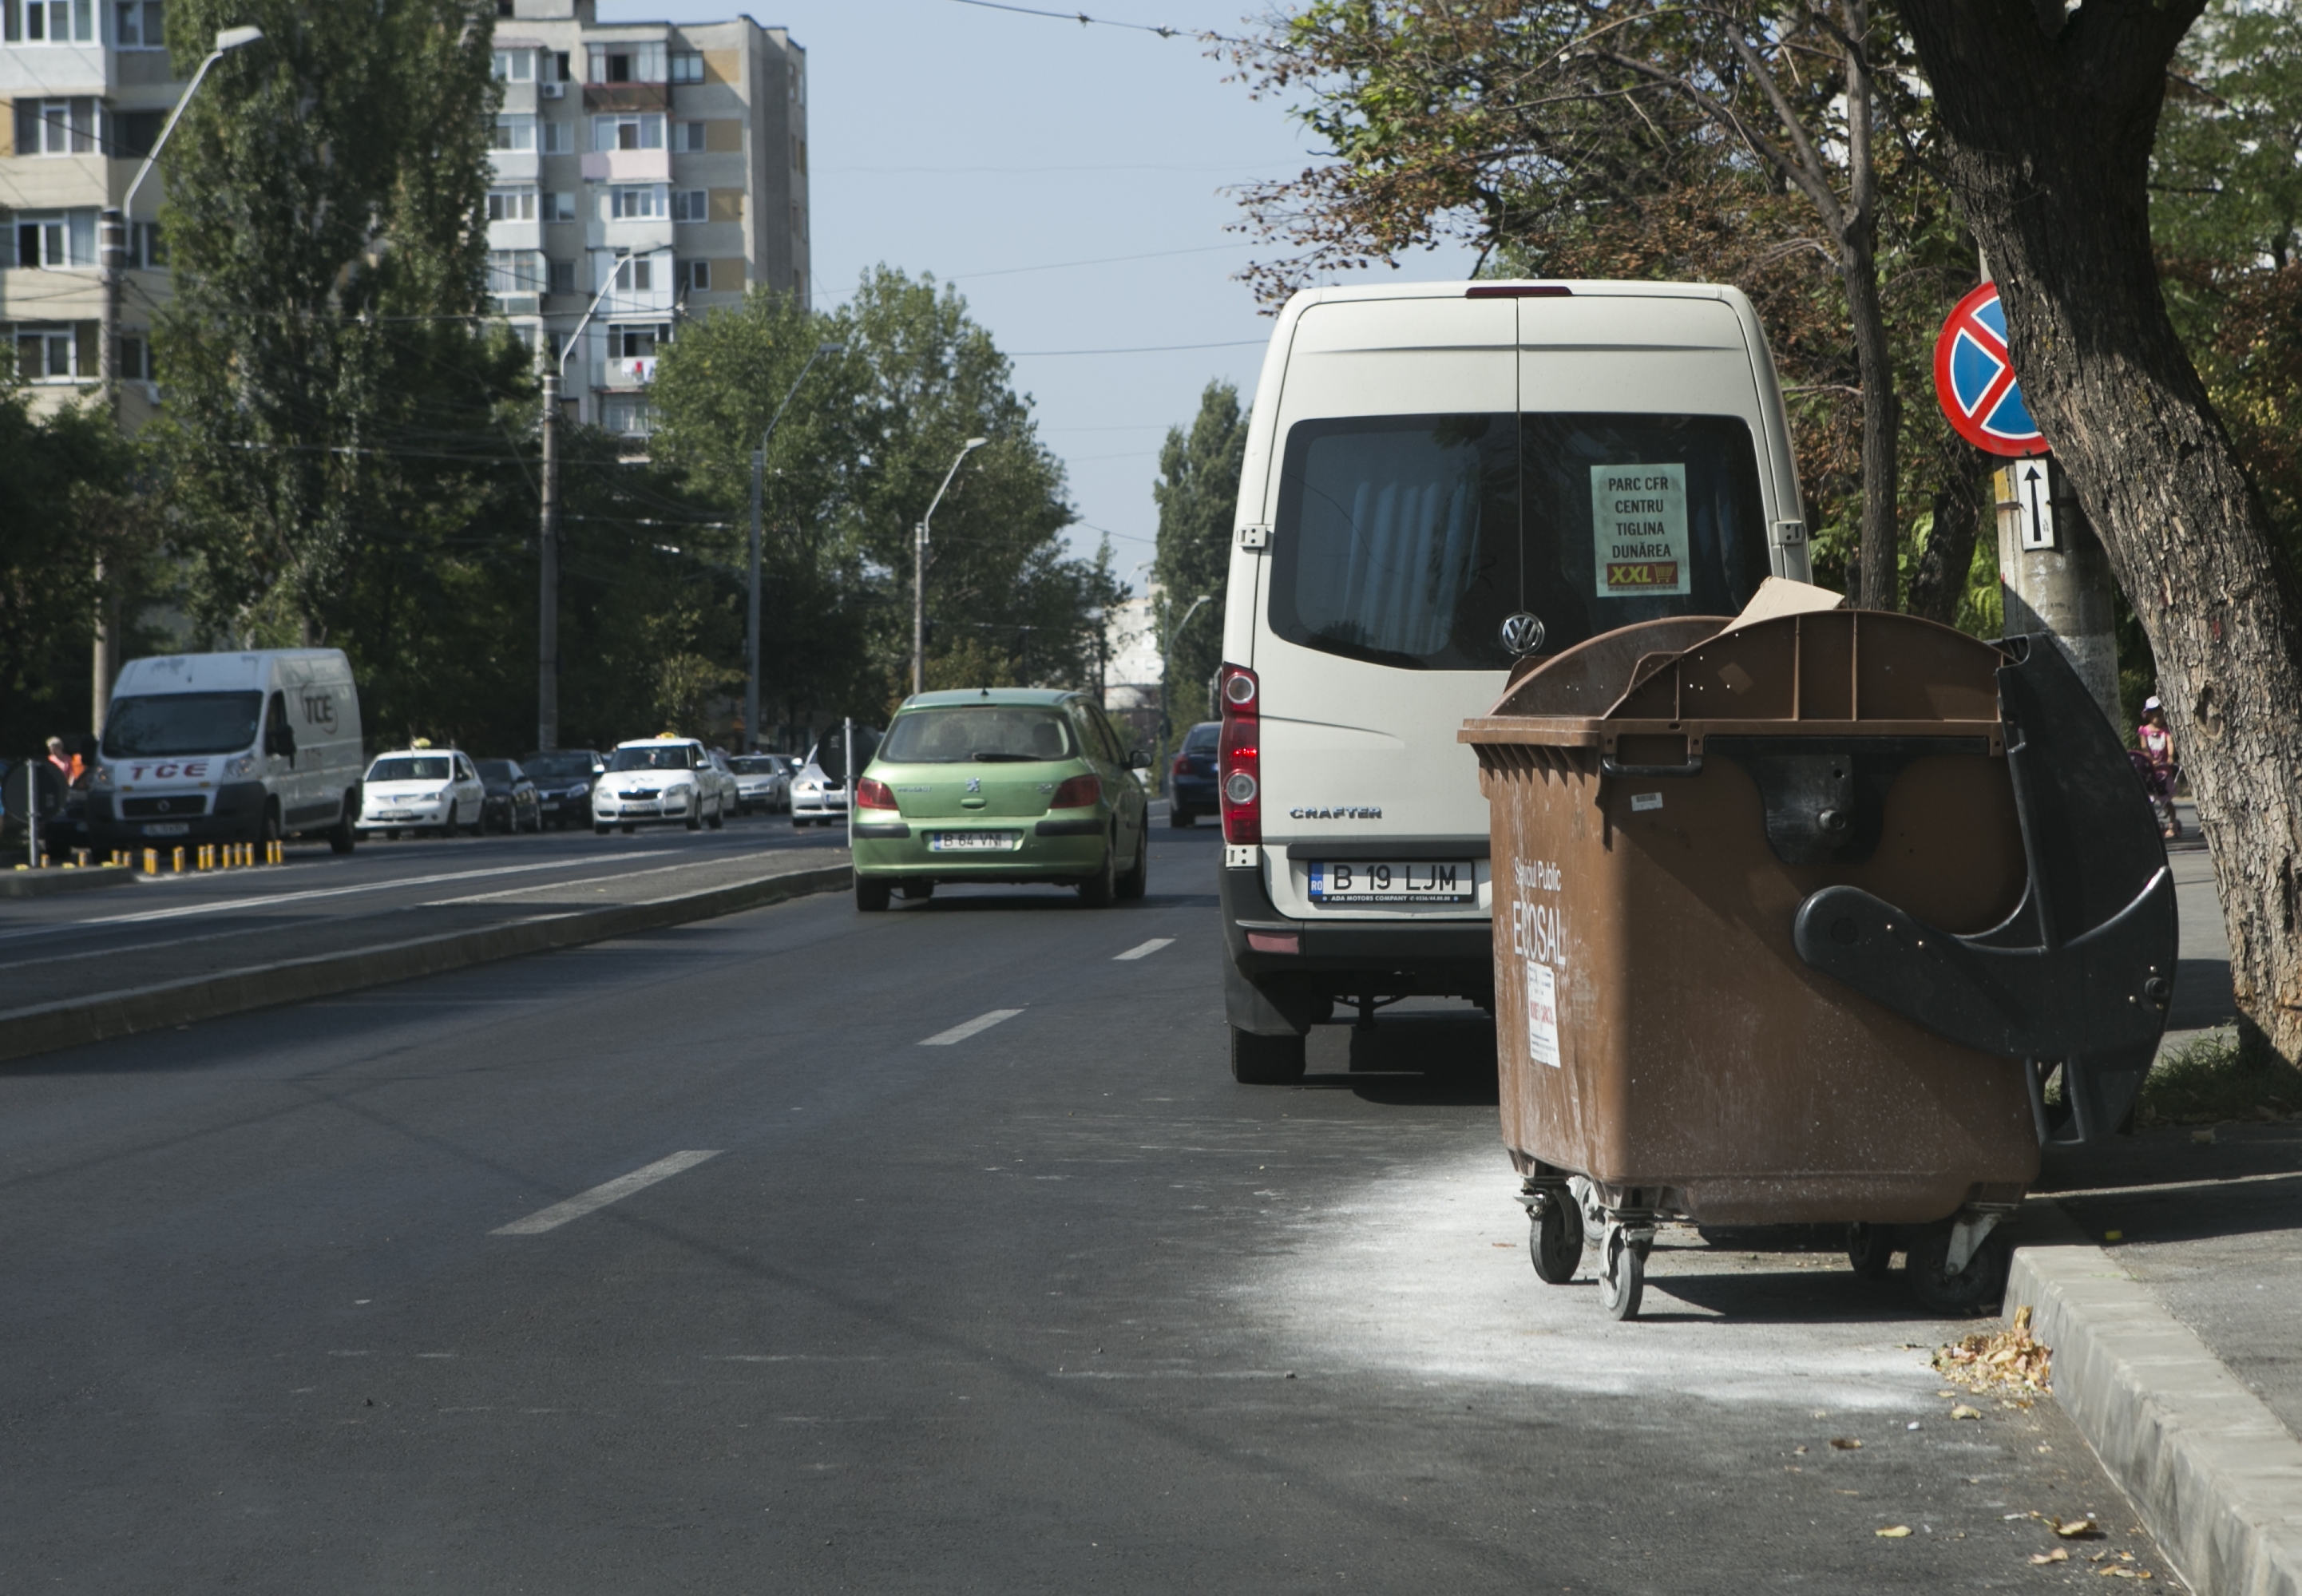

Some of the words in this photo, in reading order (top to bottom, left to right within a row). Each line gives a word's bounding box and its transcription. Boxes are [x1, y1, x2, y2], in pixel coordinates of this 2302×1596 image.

[1608, 477, 1641, 492] PARC
[1645, 477, 1669, 490] CFR
[1615, 499, 1664, 513] CENTRU
[1616, 521, 1665, 536] TIGLINA
[1612, 541, 1672, 558] DUNĂREA
[1609, 565, 1652, 584] XXL
[305, 694, 334, 724] TCE
[130, 763, 209, 781] TCE
[1290, 806, 1382, 819] CRAFTER
[944, 834, 953, 846] B
[959, 834, 973, 846] 64
[1333, 865, 1352, 890] B
[1366, 864, 1391, 890] 19
[1406, 865, 1456, 891] LJM
[1538, 860, 1561, 892] Public
[1311, 880, 1323, 891] RO
[1513, 900, 1566, 965] ECOSAL
